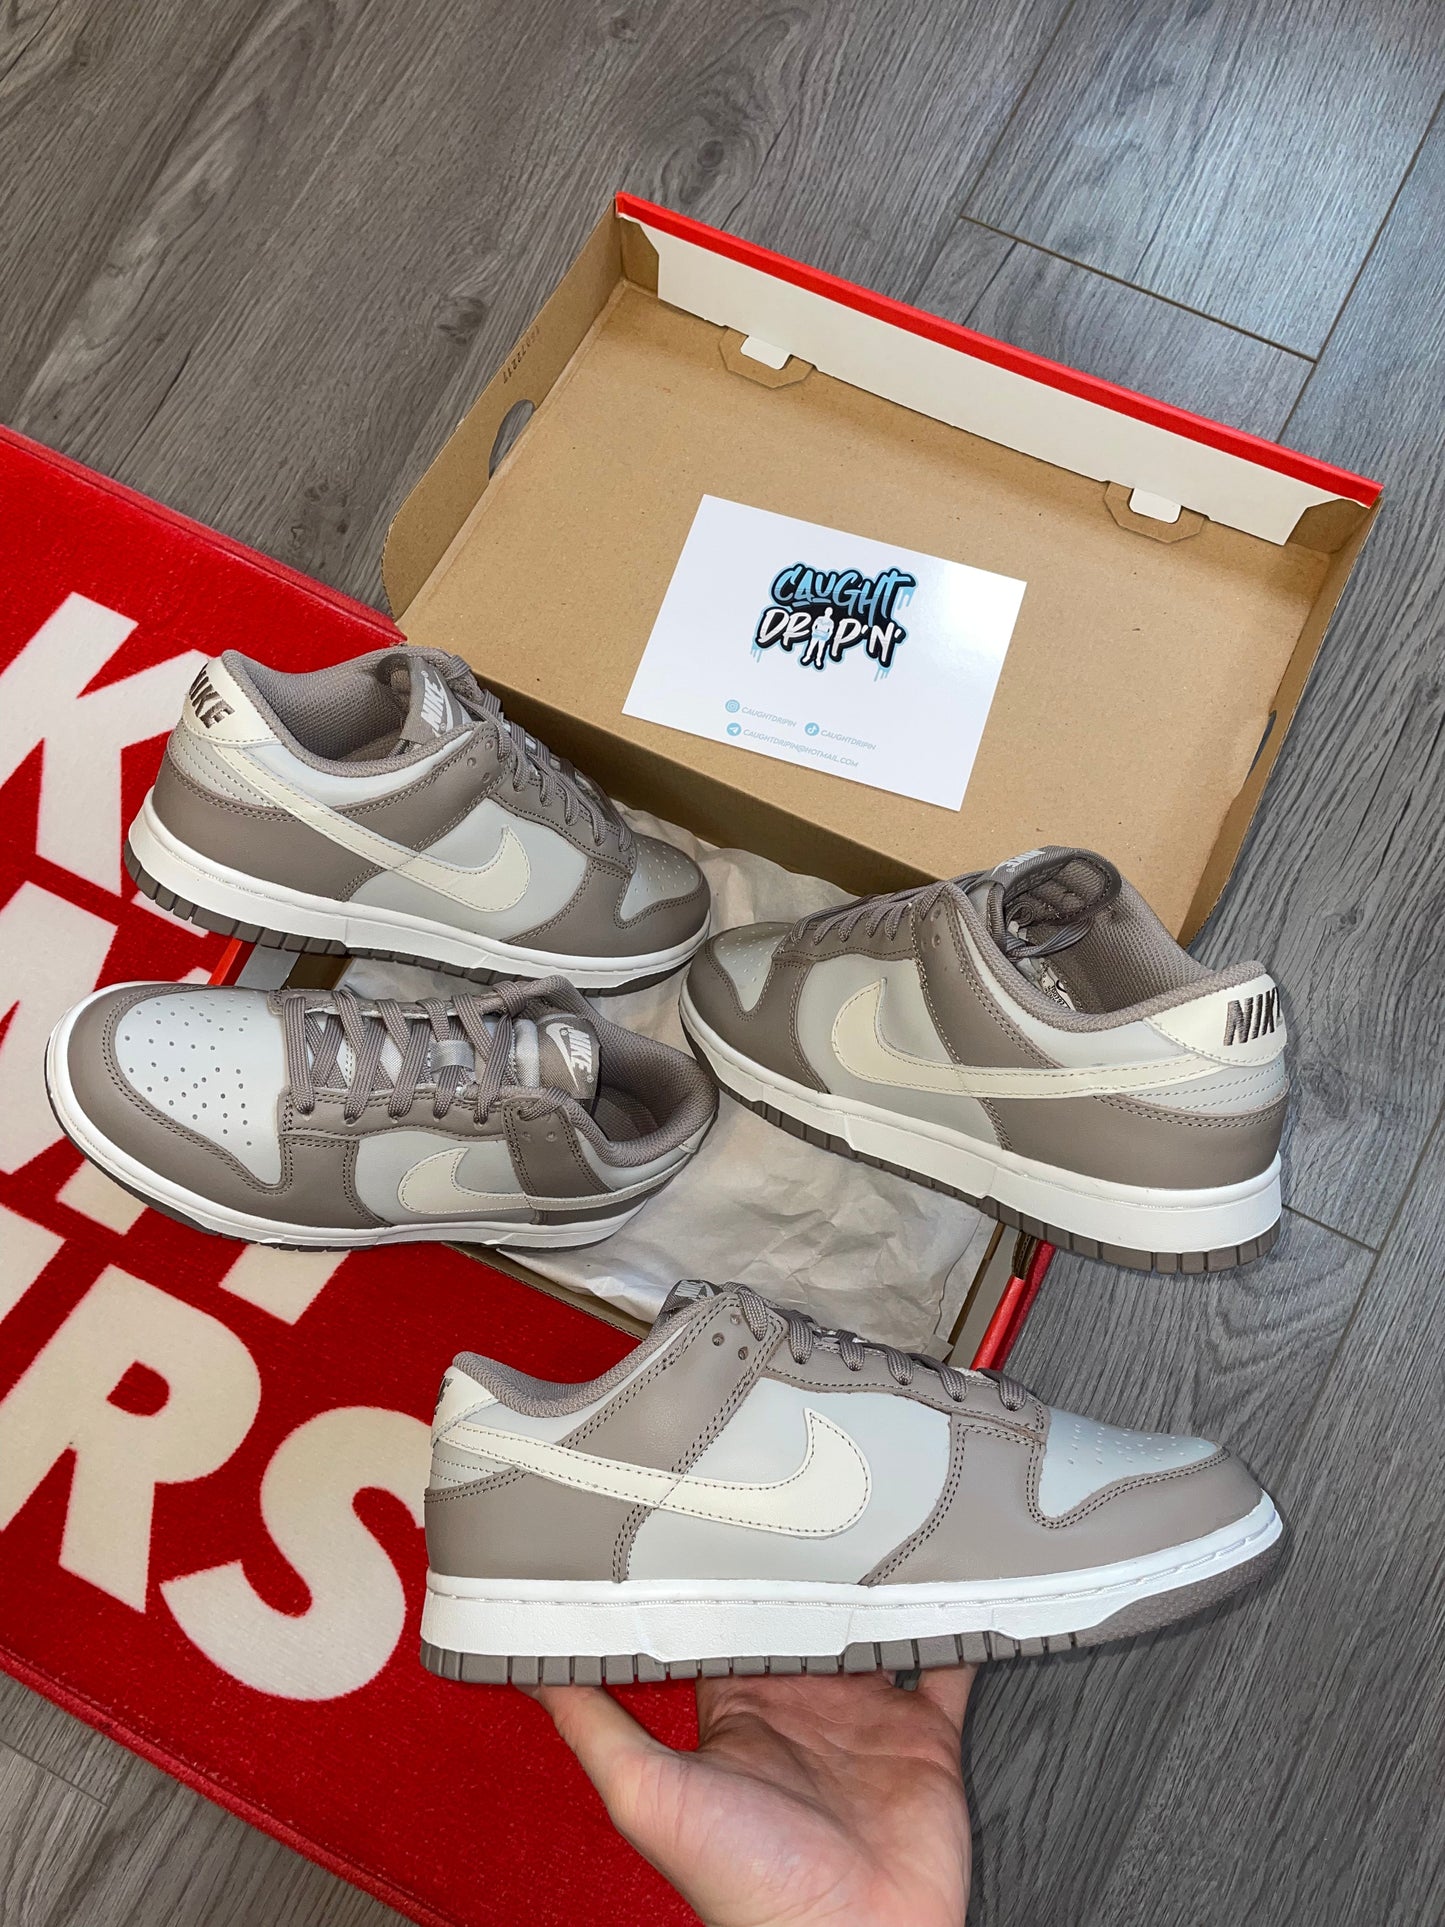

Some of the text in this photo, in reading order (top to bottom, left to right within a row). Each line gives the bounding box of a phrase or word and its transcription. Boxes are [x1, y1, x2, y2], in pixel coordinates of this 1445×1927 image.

[773, 565, 913, 628] CAUGHT
[421, 676, 445, 733] NIKE
[741, 706, 797, 728] CAUGHTDRIPIN
[743, 729, 860, 768] CAUGHTDRIPIN@HOTMAIL.COM
[820, 729, 877, 751] CAUGHTDRIPIN
[567, 1026, 593, 1074] NIKE
